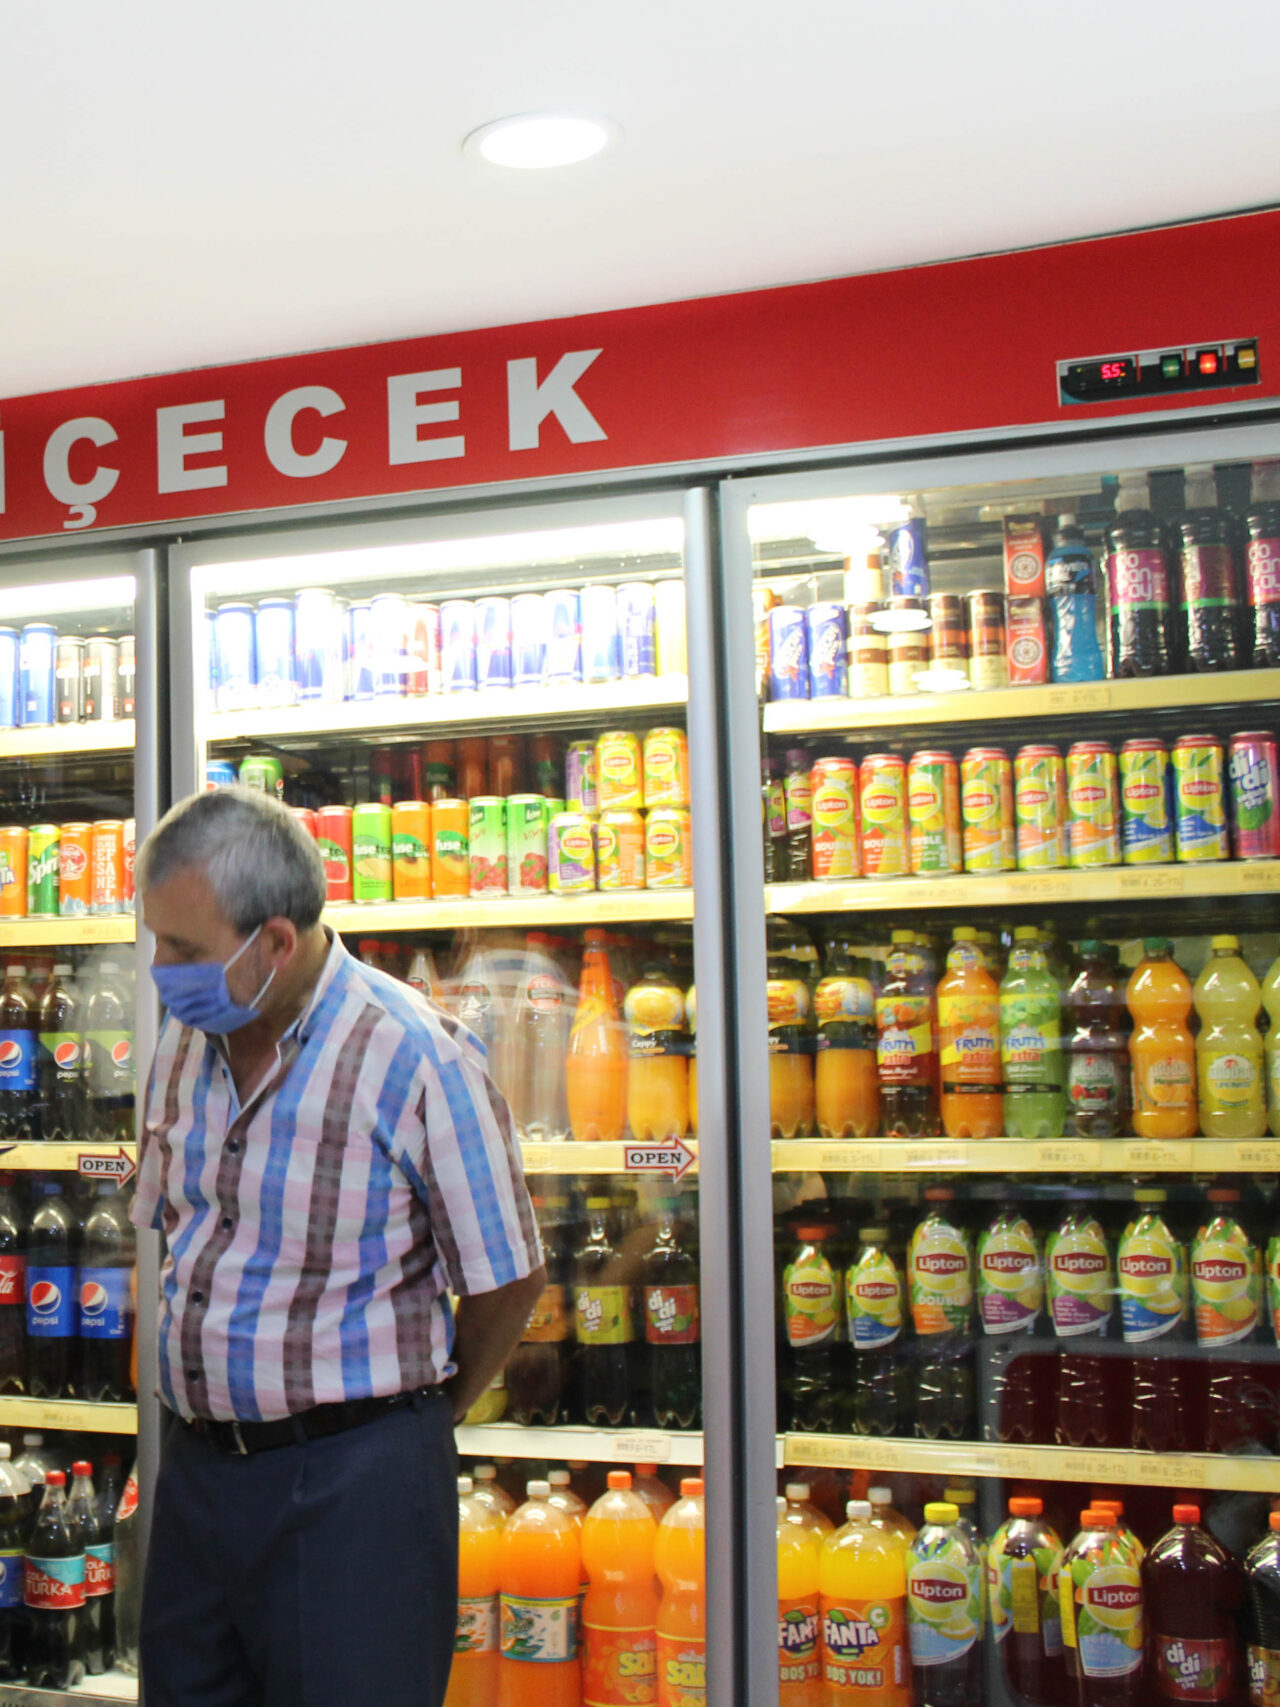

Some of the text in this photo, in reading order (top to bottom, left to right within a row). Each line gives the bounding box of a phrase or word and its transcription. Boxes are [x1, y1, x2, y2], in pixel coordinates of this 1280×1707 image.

[630, 1151, 683, 1165] OPEN
[82, 1160, 126, 1173] OPEN
[919, 1256, 966, 1271] Lipton
[1056, 1256, 1104, 1272] Lipton
[1122, 1260, 1168, 1274] Lipton
[1194, 1263, 1243, 1278] Lipton
[793, 1284, 830, 1296] Lipton
[857, 1284, 896, 1297] Lipton
[28, 1579, 72, 1597] TURKA
[913, 1581, 964, 1599] Lipton
[822, 1618, 880, 1647] FANTA
